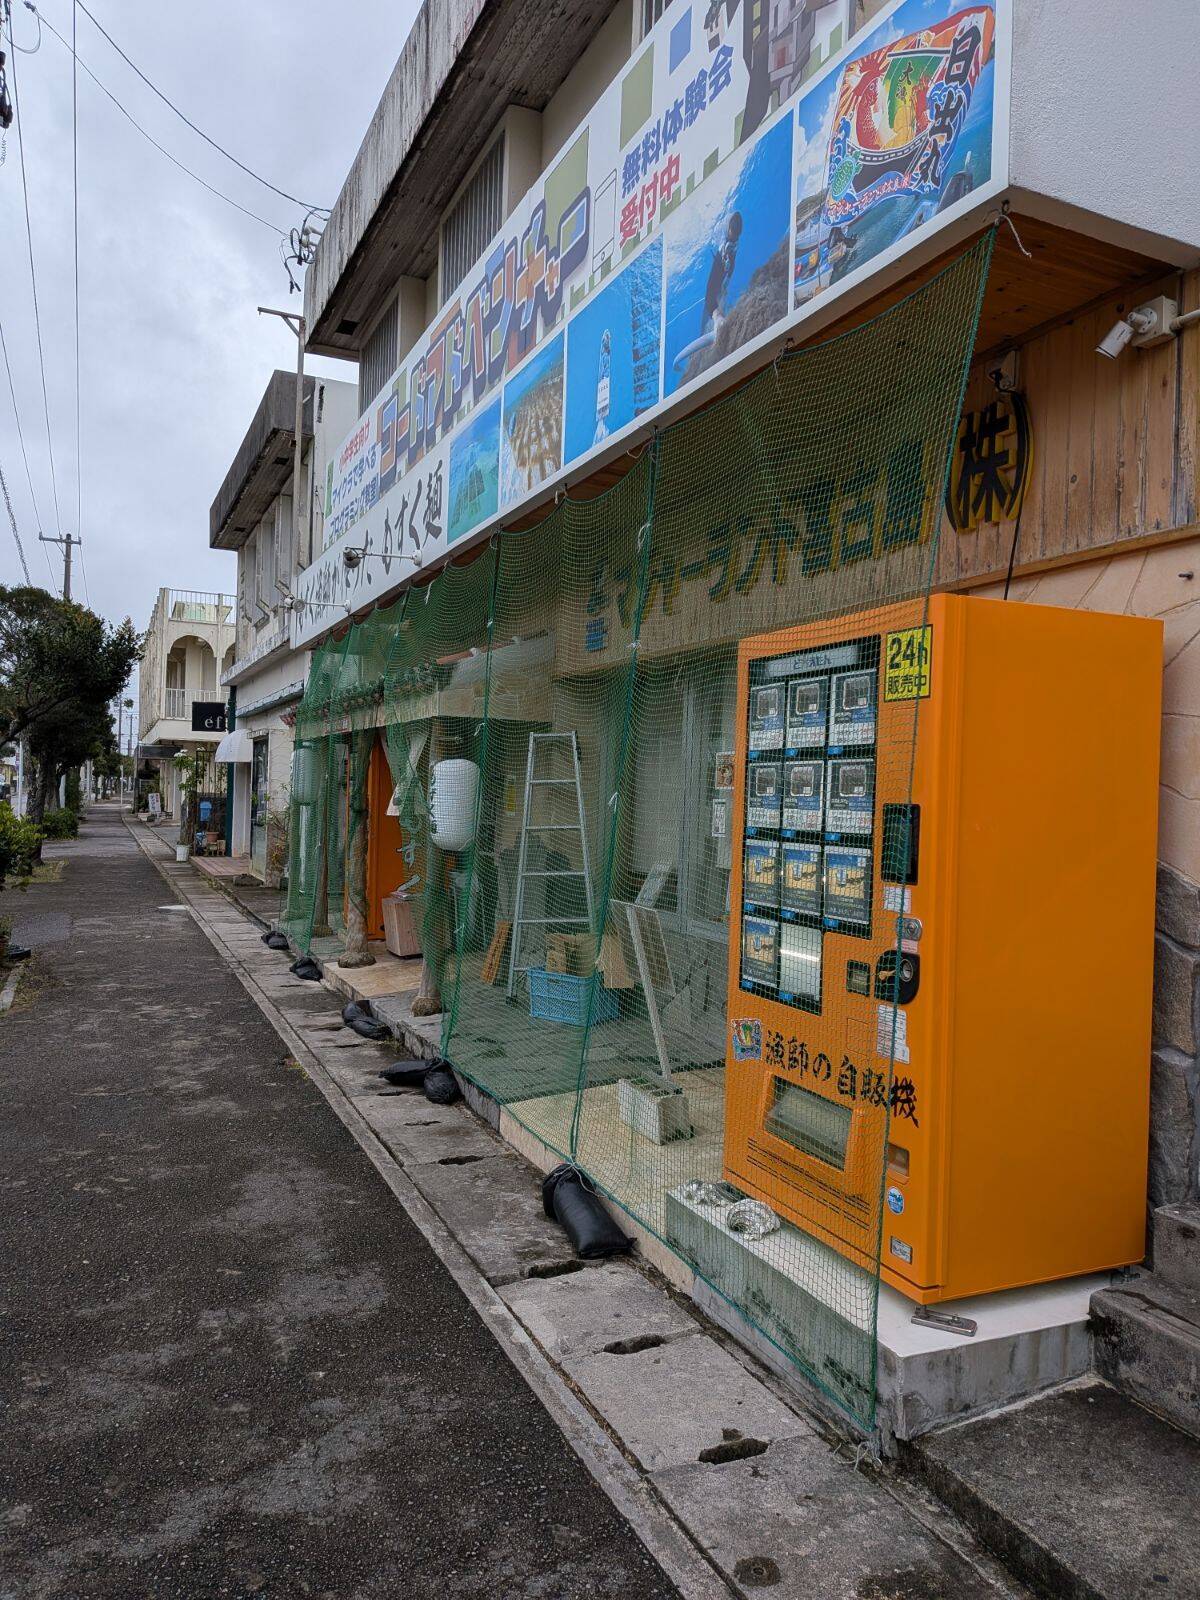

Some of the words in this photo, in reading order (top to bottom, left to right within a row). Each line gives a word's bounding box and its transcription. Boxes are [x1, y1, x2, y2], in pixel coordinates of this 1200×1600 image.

[621, 44, 734, 199] 無料体験会
[619, 152, 681, 249] 受付中
[380, 188, 590, 481] コードアドベンチャー
[330, 477, 378, 537] プログラミング教室
[332, 443, 378, 507] マイクラで学べる
[888, 674, 927, 694] 販売中
[889, 634, 928, 669] 24h
[765, 1029, 920, 1129] 漁師の自販機
